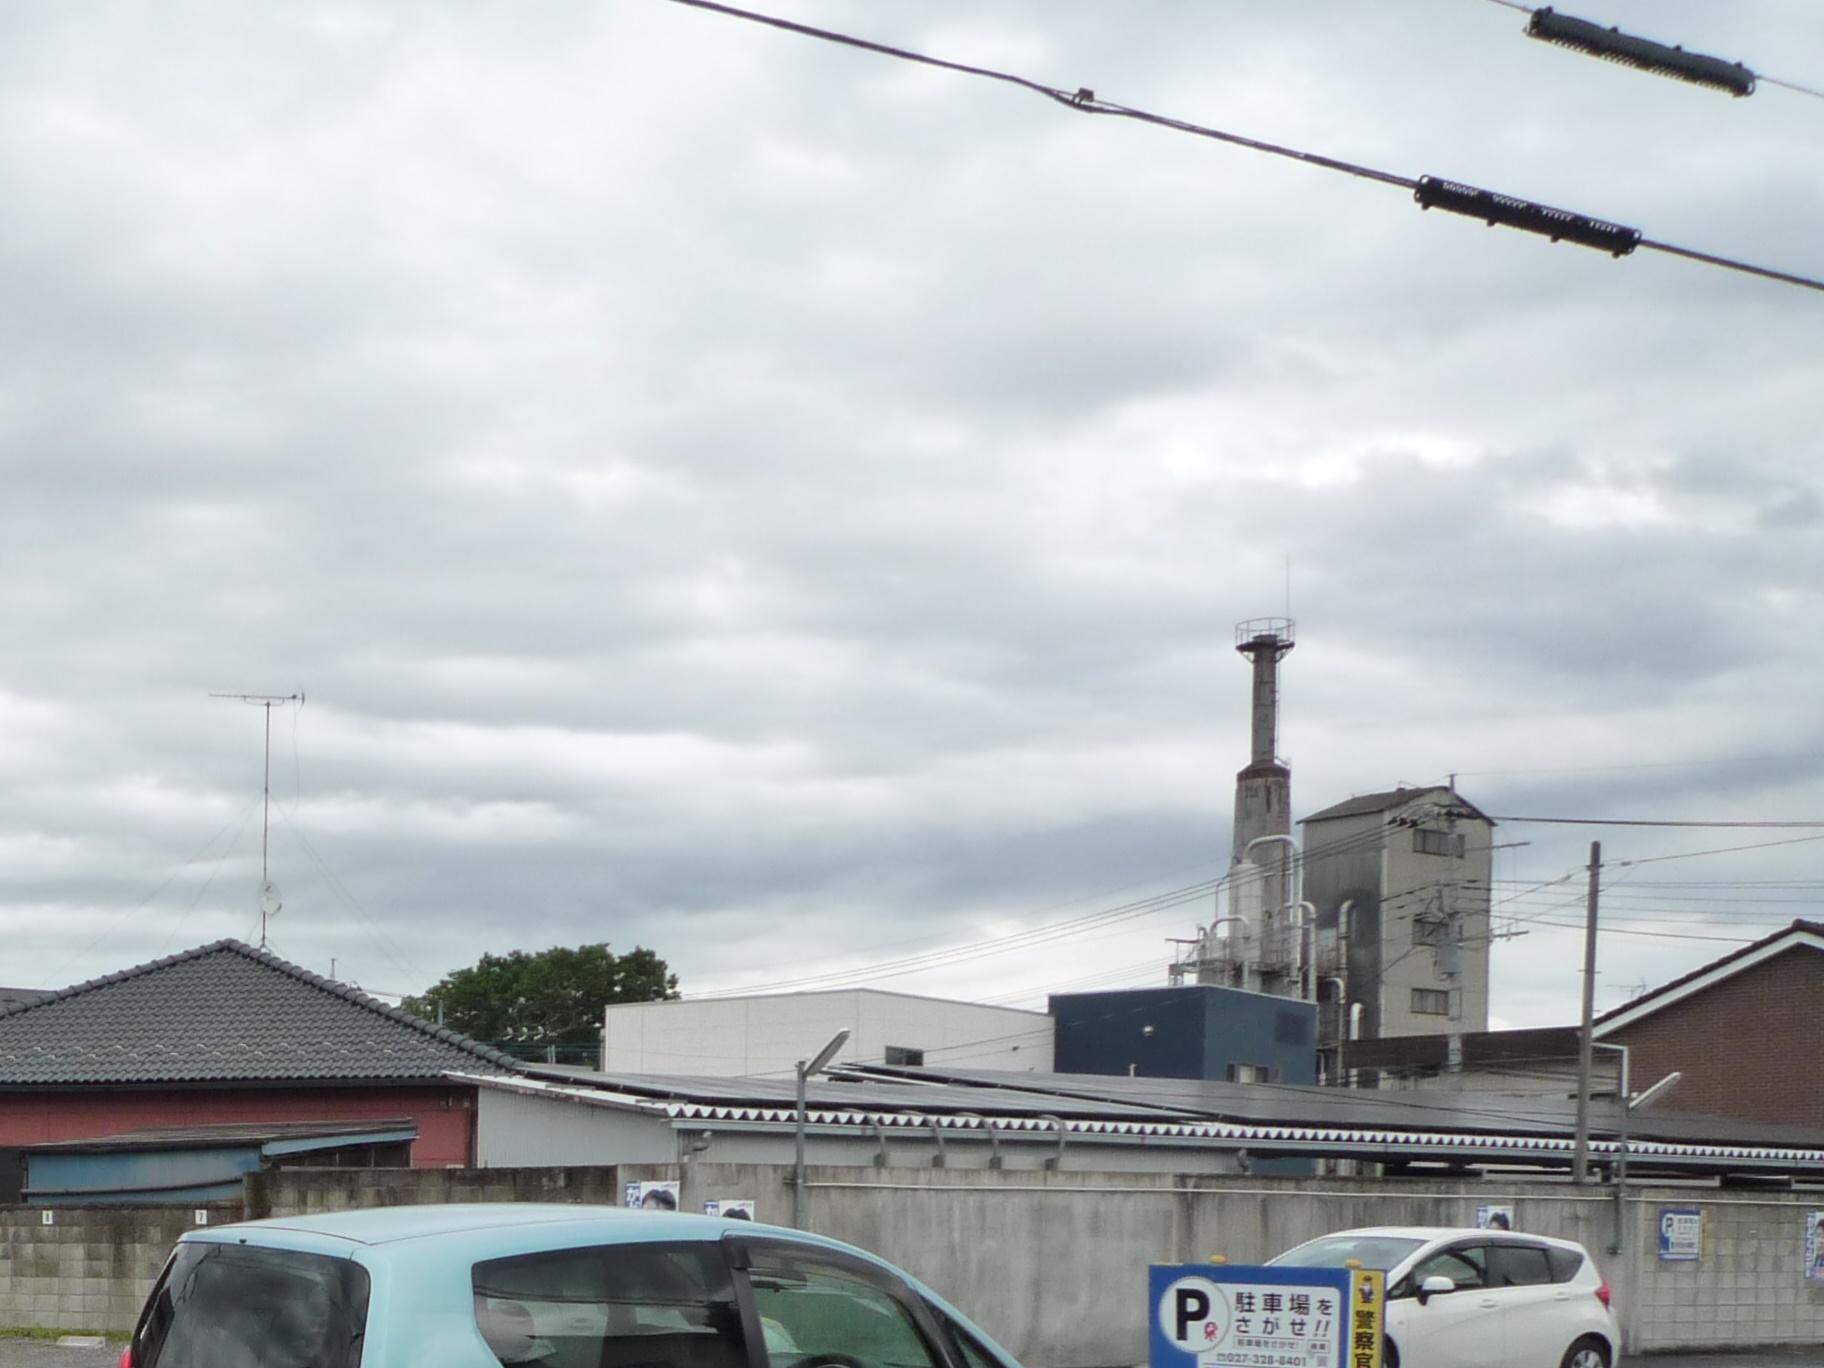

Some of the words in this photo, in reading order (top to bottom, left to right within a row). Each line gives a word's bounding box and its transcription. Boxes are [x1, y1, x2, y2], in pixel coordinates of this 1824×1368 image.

[1176, 1288, 1210, 1341] P
[1235, 1291, 1333, 1316] 駐車場を
